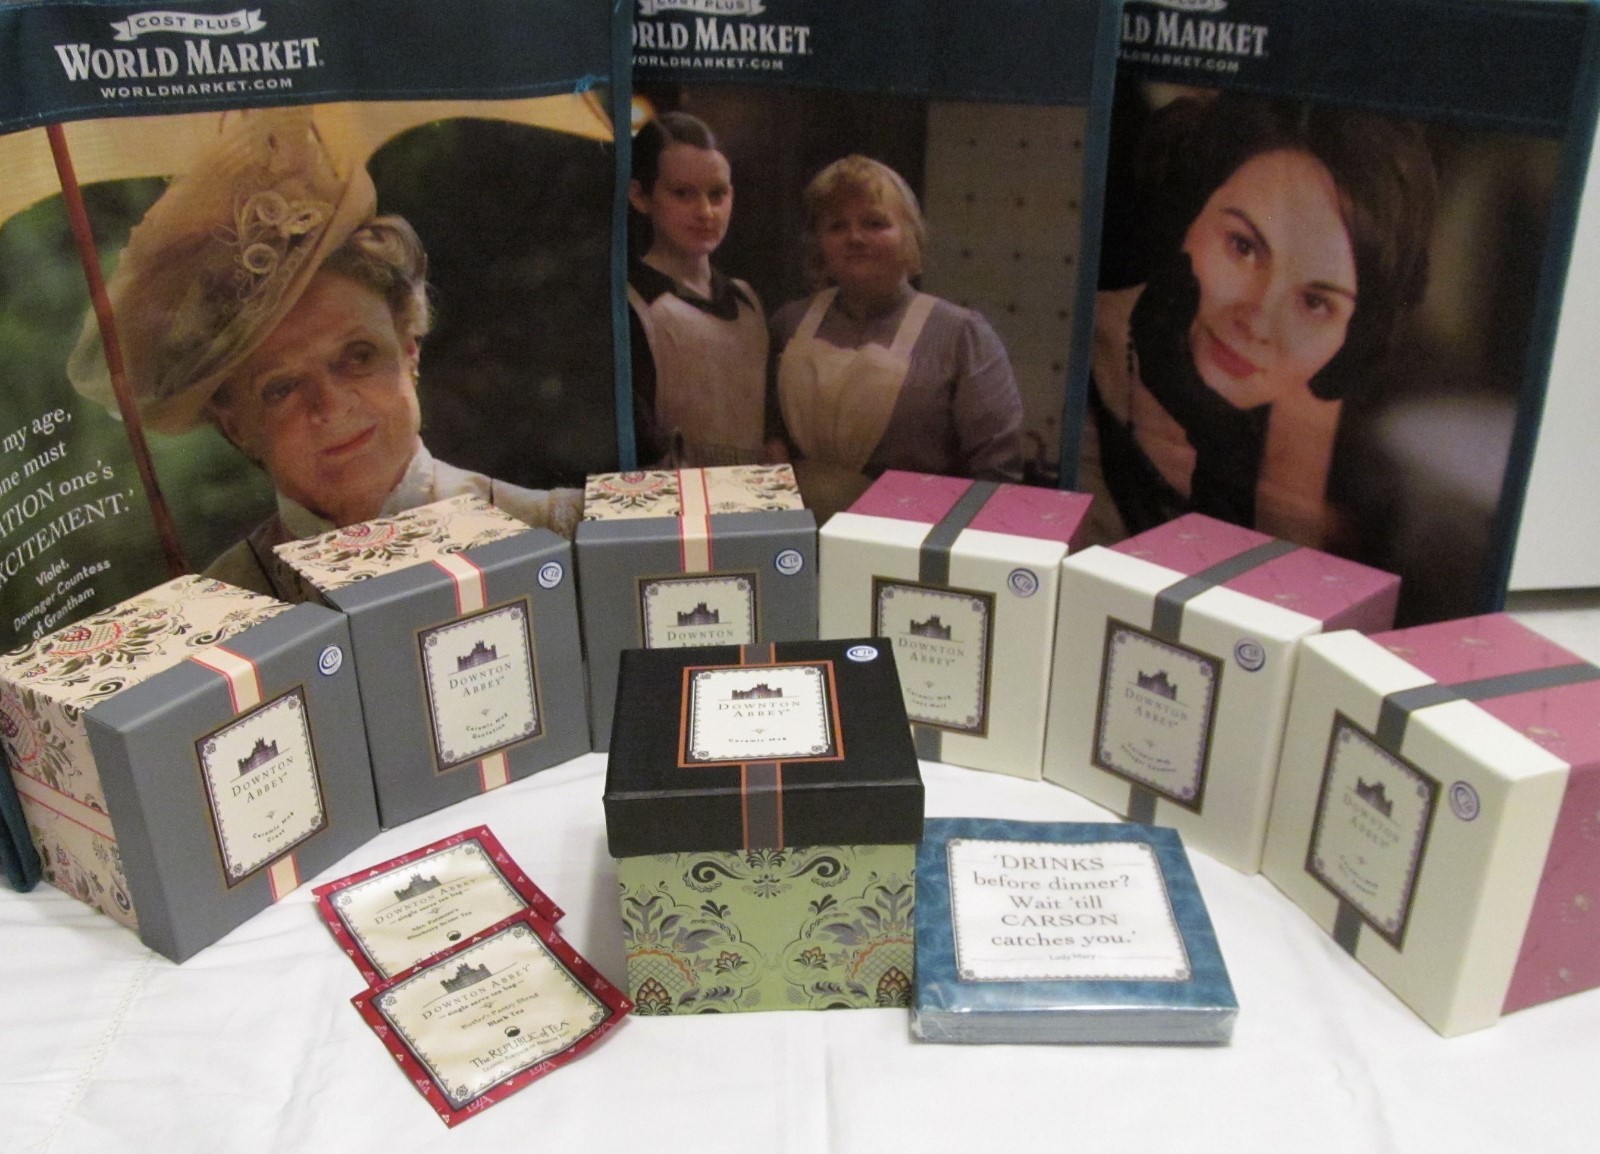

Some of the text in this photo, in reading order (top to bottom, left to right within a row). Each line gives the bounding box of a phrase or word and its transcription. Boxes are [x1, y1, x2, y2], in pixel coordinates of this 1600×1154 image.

[136, 16, 242, 30] COST PLUS
[55, 43, 179, 81] WORLD
[100, 77, 293, 98] WORLDMARKET.COM
[2, 406, 73, 454] my age,
[23, 440, 67, 472] must
[59, 459, 114, 496] one's
[13, 559, 111, 632] Dowager Countess
[32, 585, 95, 641] of Grantham
[667, 629, 734, 642] DOWNTON
[898, 637, 965, 657] DOWNTON
[449, 660, 512, 691] DOWNTON
[718, 700, 800, 711] DOWNTON
[231, 755, 295, 798] DOWNTON
[993, 854, 1105, 872] 'DRINKS
[974, 871, 1130, 890] before dinner?
[450, 889, 465, 899] bag
[1008, 895, 1103, 910] Wait 'till
[374, 892, 436, 925] DOWNTON
[1001, 913, 1120, 927] CARSON
[991, 931, 1137, 947] catches you.'
[421, 964, 530, 1020] DOWNTON ABBEY
[447, 981, 519, 1019] single serve tea bag
[491, 1002, 516, 1019] Pantry
[515, 992, 540, 1007] Blend
[487, 1008, 525, 1028] Black Tea
[469, 1055, 491, 1069] The
